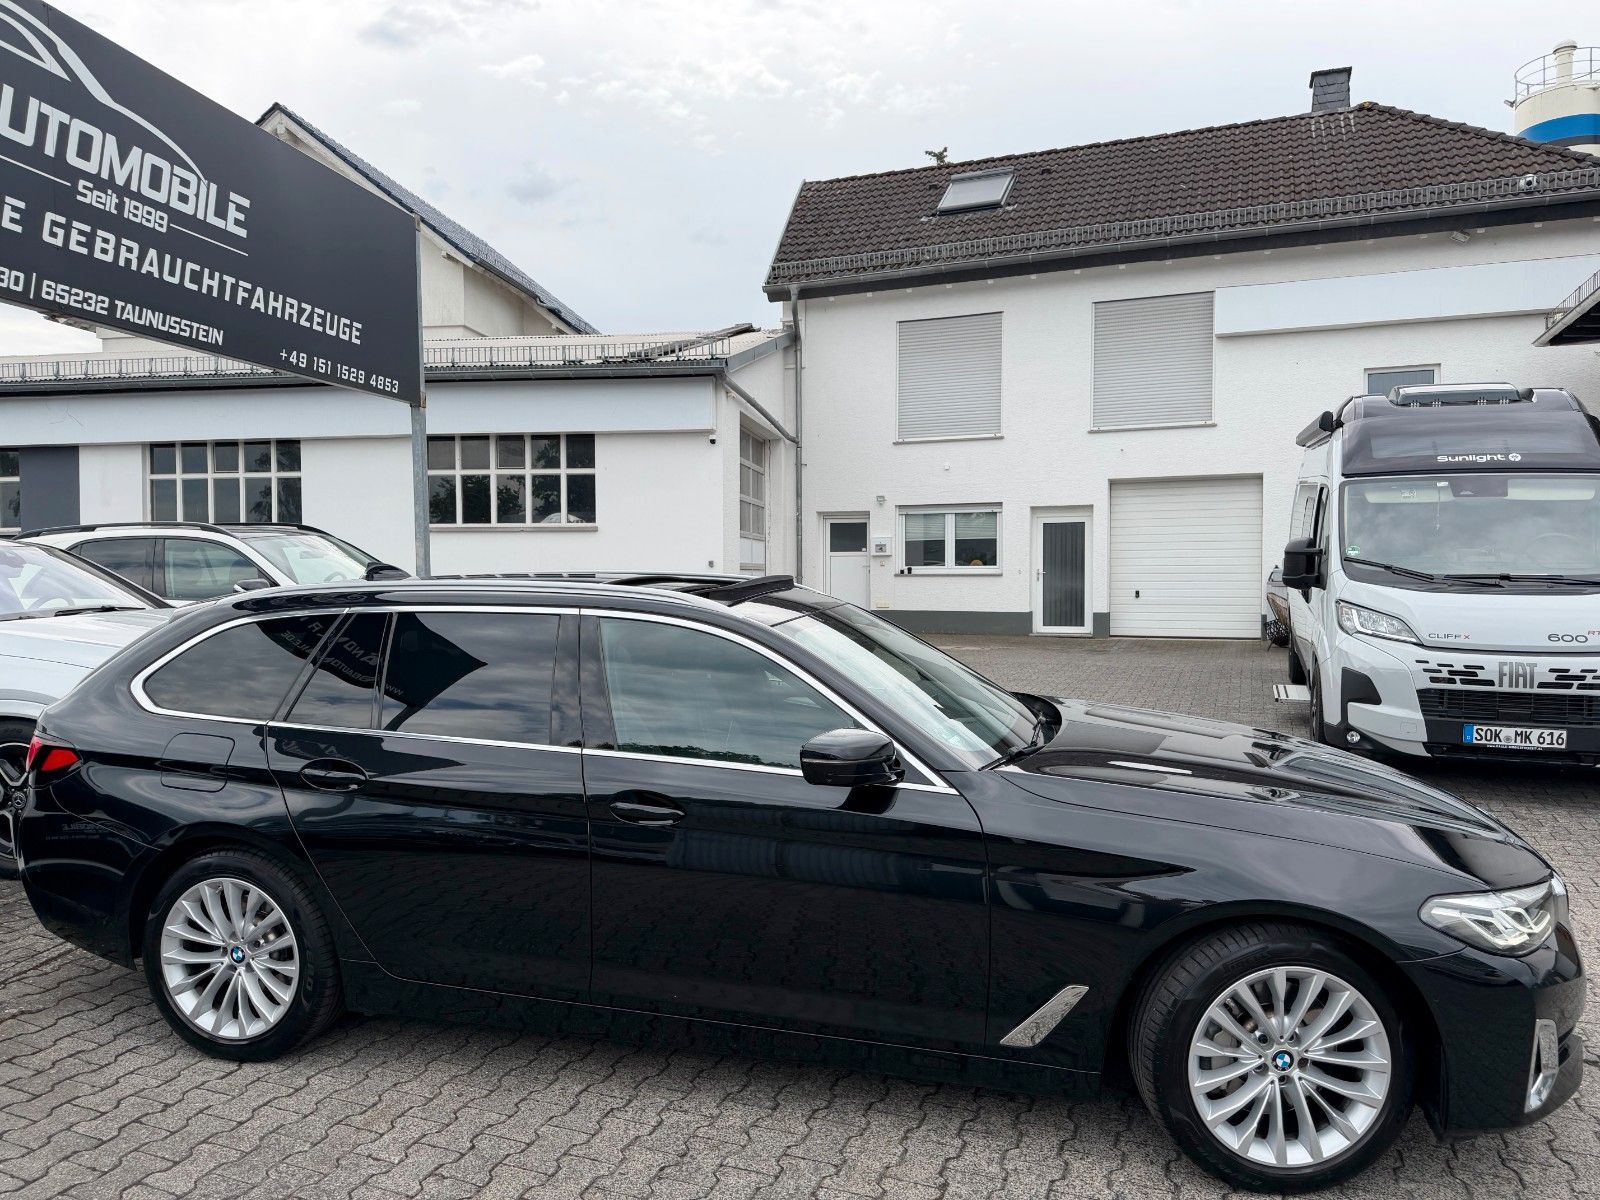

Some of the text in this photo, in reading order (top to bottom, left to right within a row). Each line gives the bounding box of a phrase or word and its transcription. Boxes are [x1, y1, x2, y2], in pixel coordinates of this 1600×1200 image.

[77, 179, 169, 233] Seit 1999
[42, 211, 362, 345] GEBRAUCHTFAHRZEUGE
[41, 279, 109, 316] 65232
[114, 299, 224, 346] TAUNUSSTEIN
[279, 349, 399, 393] +49 151 1529 4853
[1437, 453, 1506, 463] Sunlight
[1547, 633, 1588, 643] 600
[1498, 661, 1538, 689] FIAT
[1474, 728, 1565, 746] SOK MK 616
